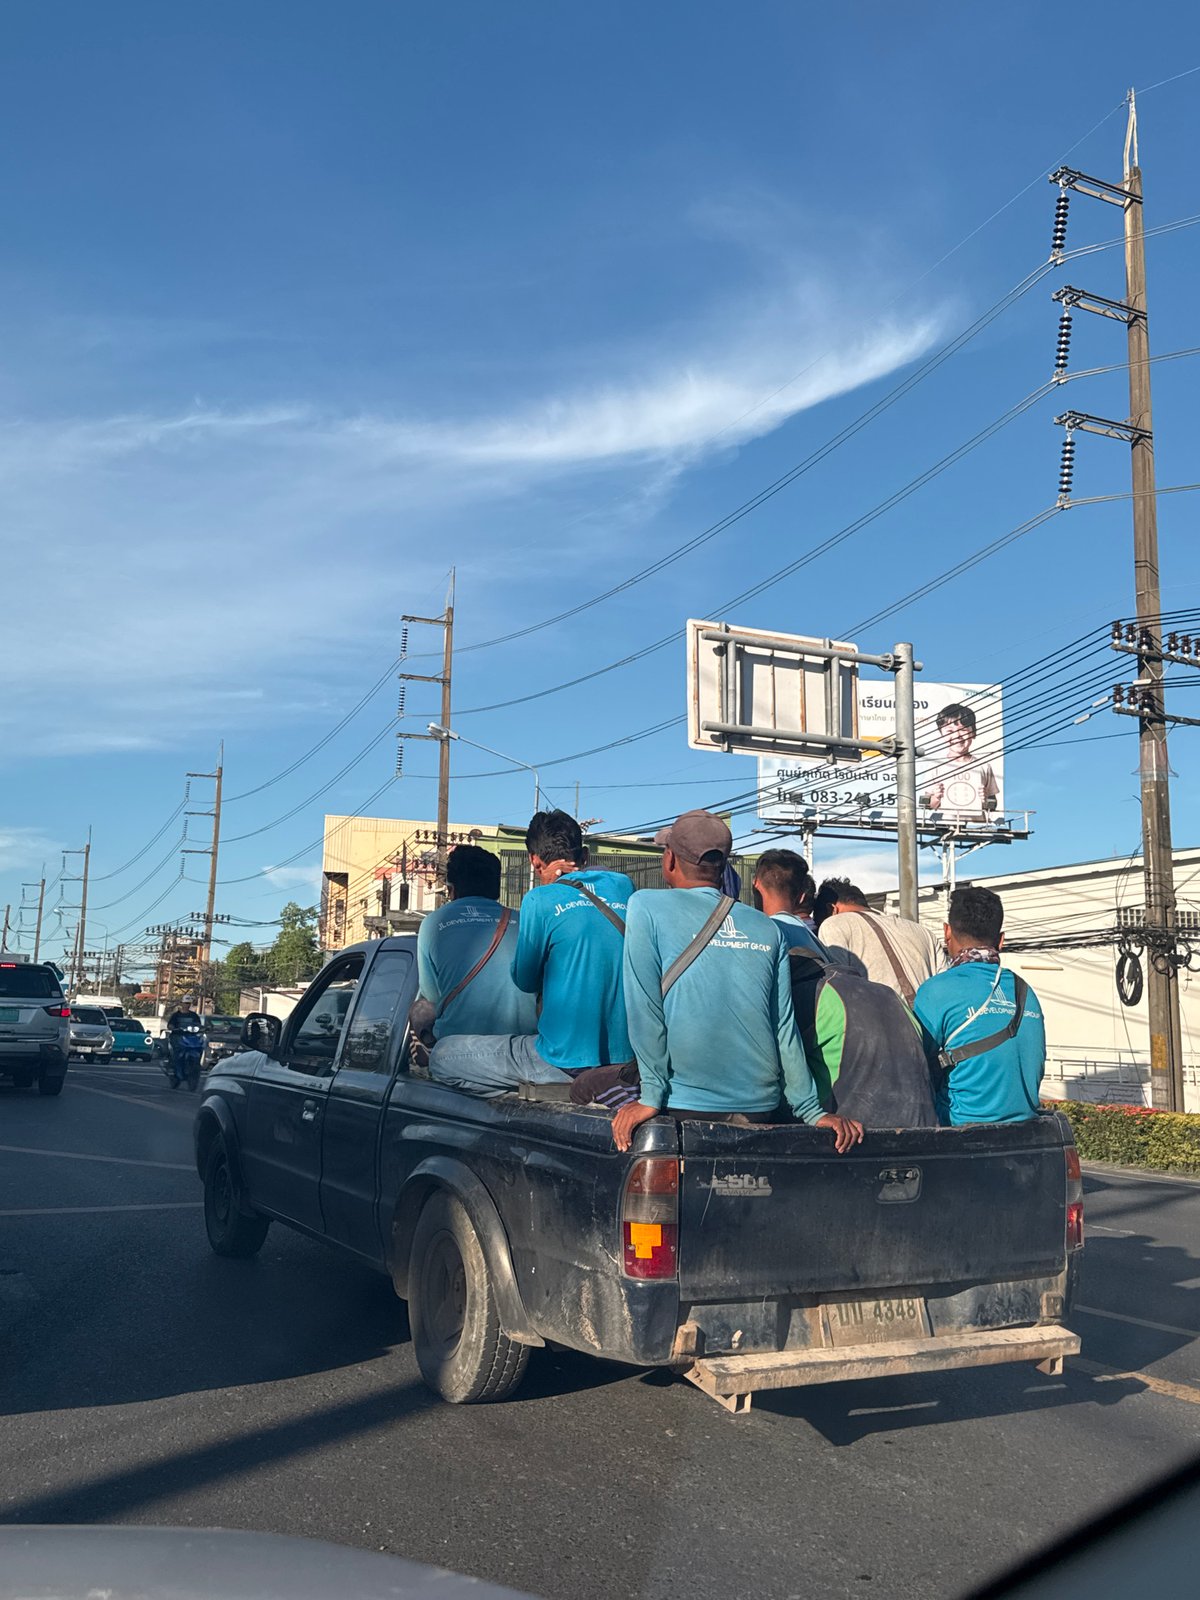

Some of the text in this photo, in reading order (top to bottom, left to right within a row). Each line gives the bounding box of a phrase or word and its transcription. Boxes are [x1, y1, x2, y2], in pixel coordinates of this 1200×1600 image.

[554, 904, 566, 916] JL
[446, 918, 493, 927] DEVELOPMENT
[750, 942, 771, 952] GROUP
[873, 1299, 916, 1323] 4348
